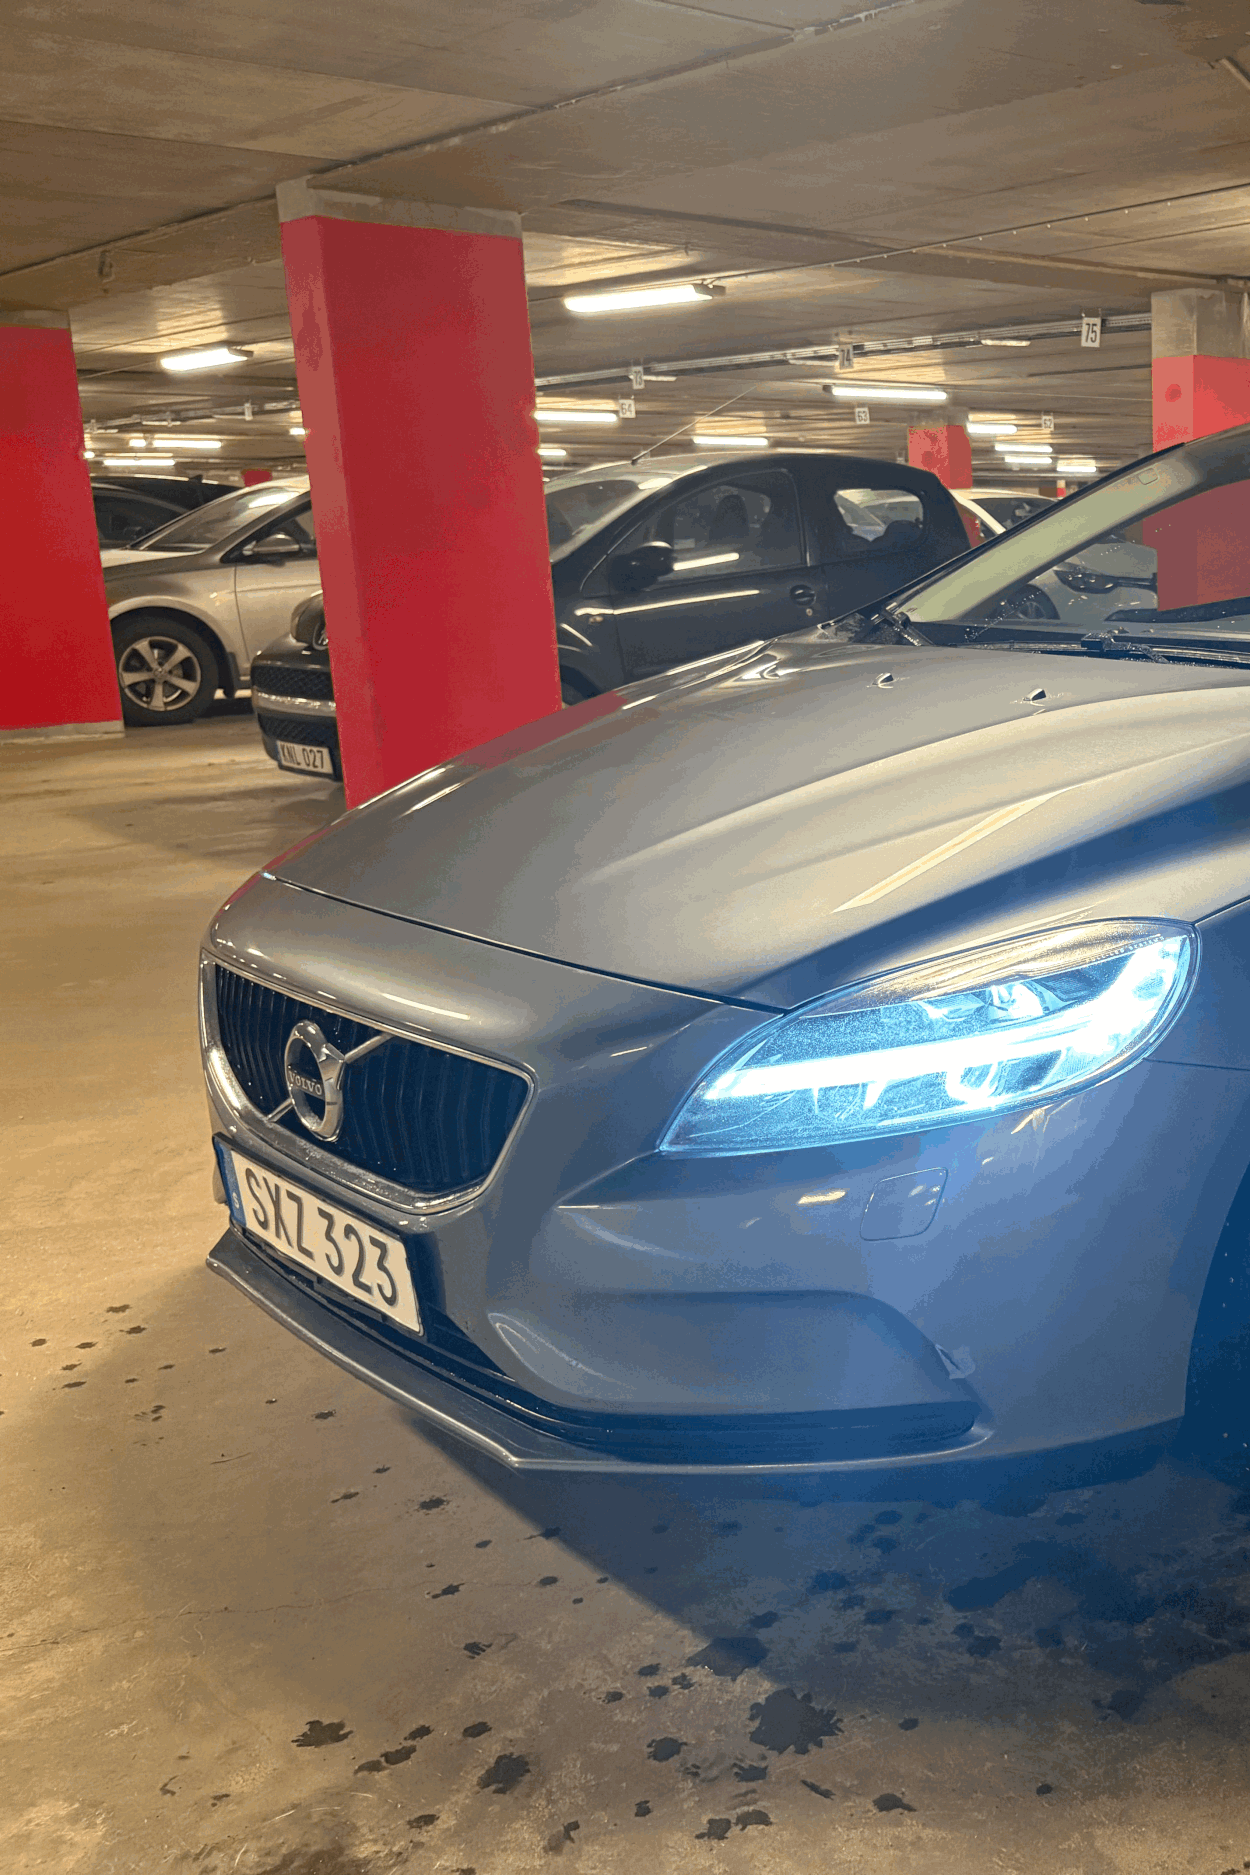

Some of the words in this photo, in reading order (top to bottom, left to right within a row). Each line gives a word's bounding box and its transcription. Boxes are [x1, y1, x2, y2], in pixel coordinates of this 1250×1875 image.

[1085, 323, 1097, 343] 75
[840, 348, 852, 367] 74
[621, 402, 633, 416] 64
[280, 743, 301, 766] KNL
[302, 748, 324, 769] 027
[289, 1070, 322, 1095] VOLVO
[245, 1167, 316, 1263] SXZ
[317, 1206, 399, 1307] 323
